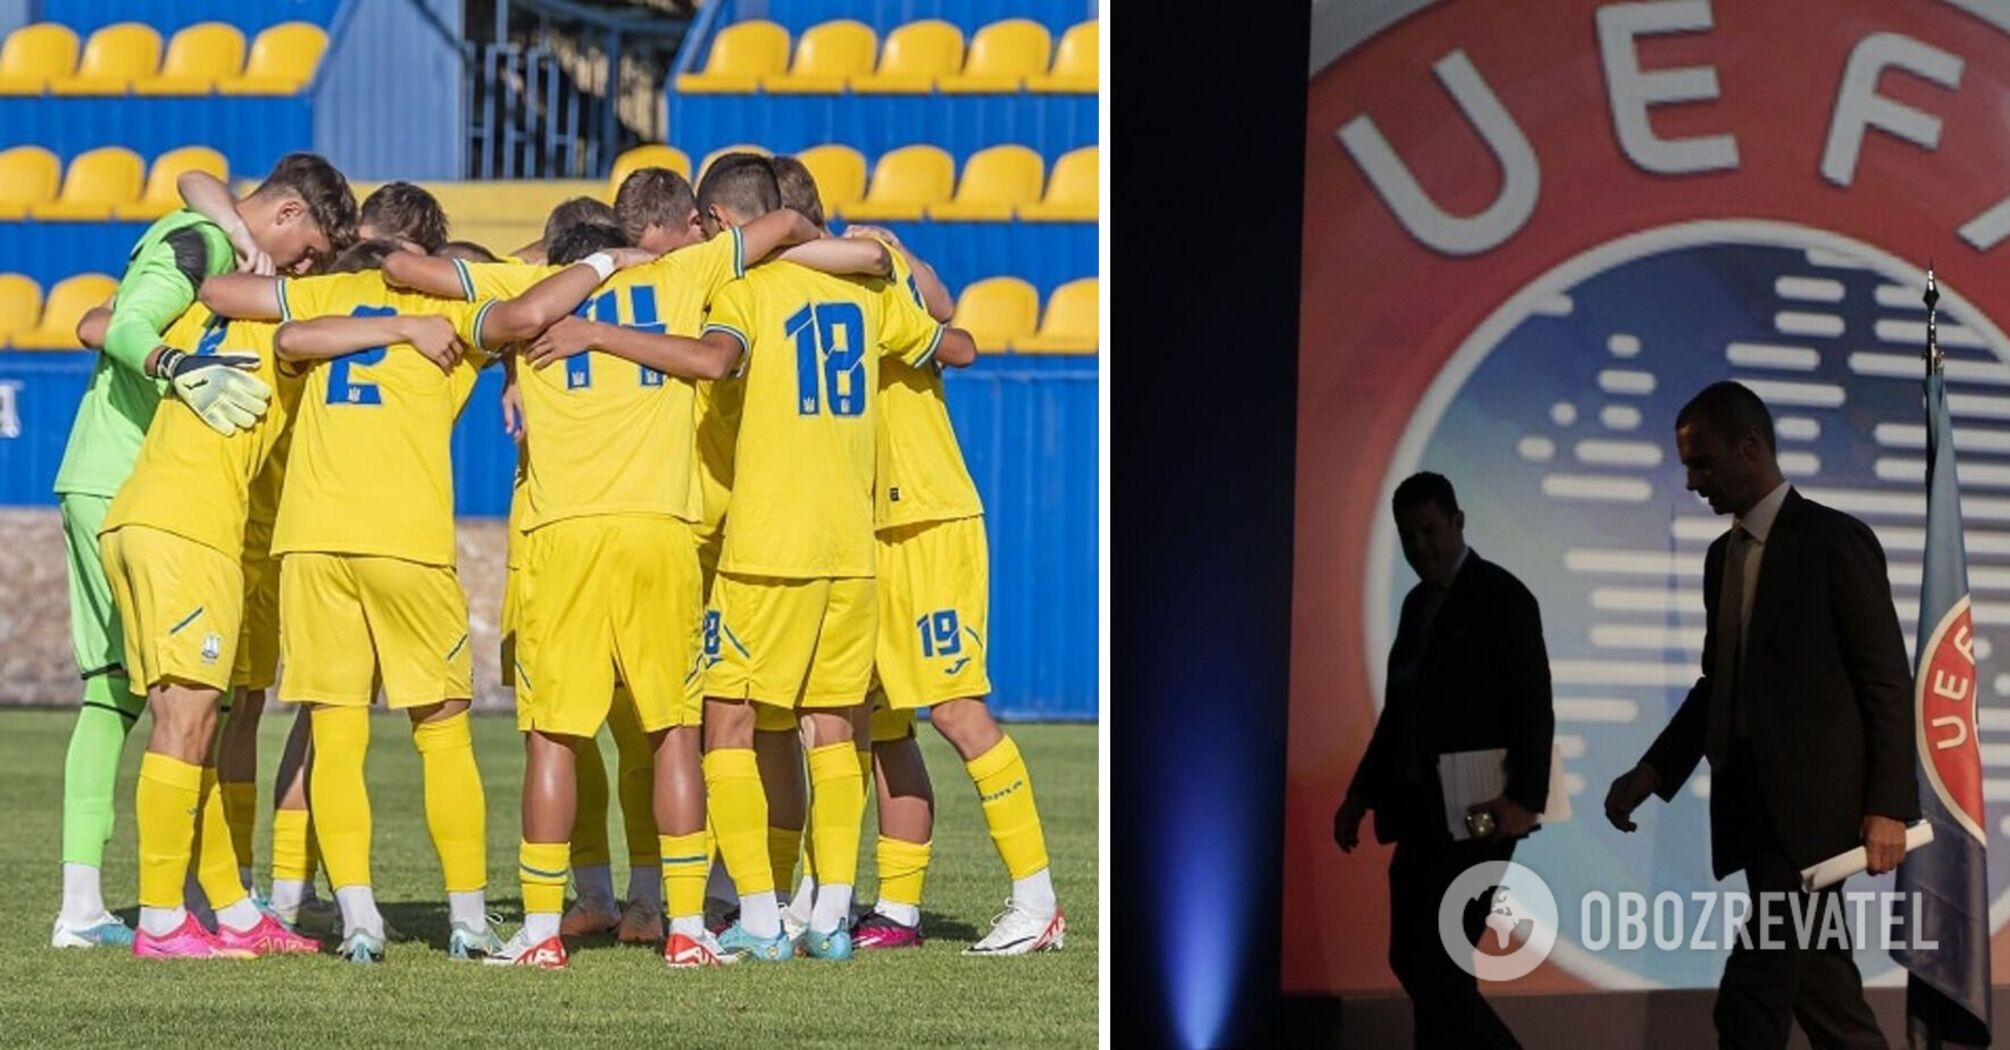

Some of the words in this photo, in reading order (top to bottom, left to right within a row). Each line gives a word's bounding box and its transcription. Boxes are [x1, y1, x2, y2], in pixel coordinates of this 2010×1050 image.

[325, 305, 397, 404] 2
[785, 302, 866, 416] 18
[916, 609, 961, 657] 19
